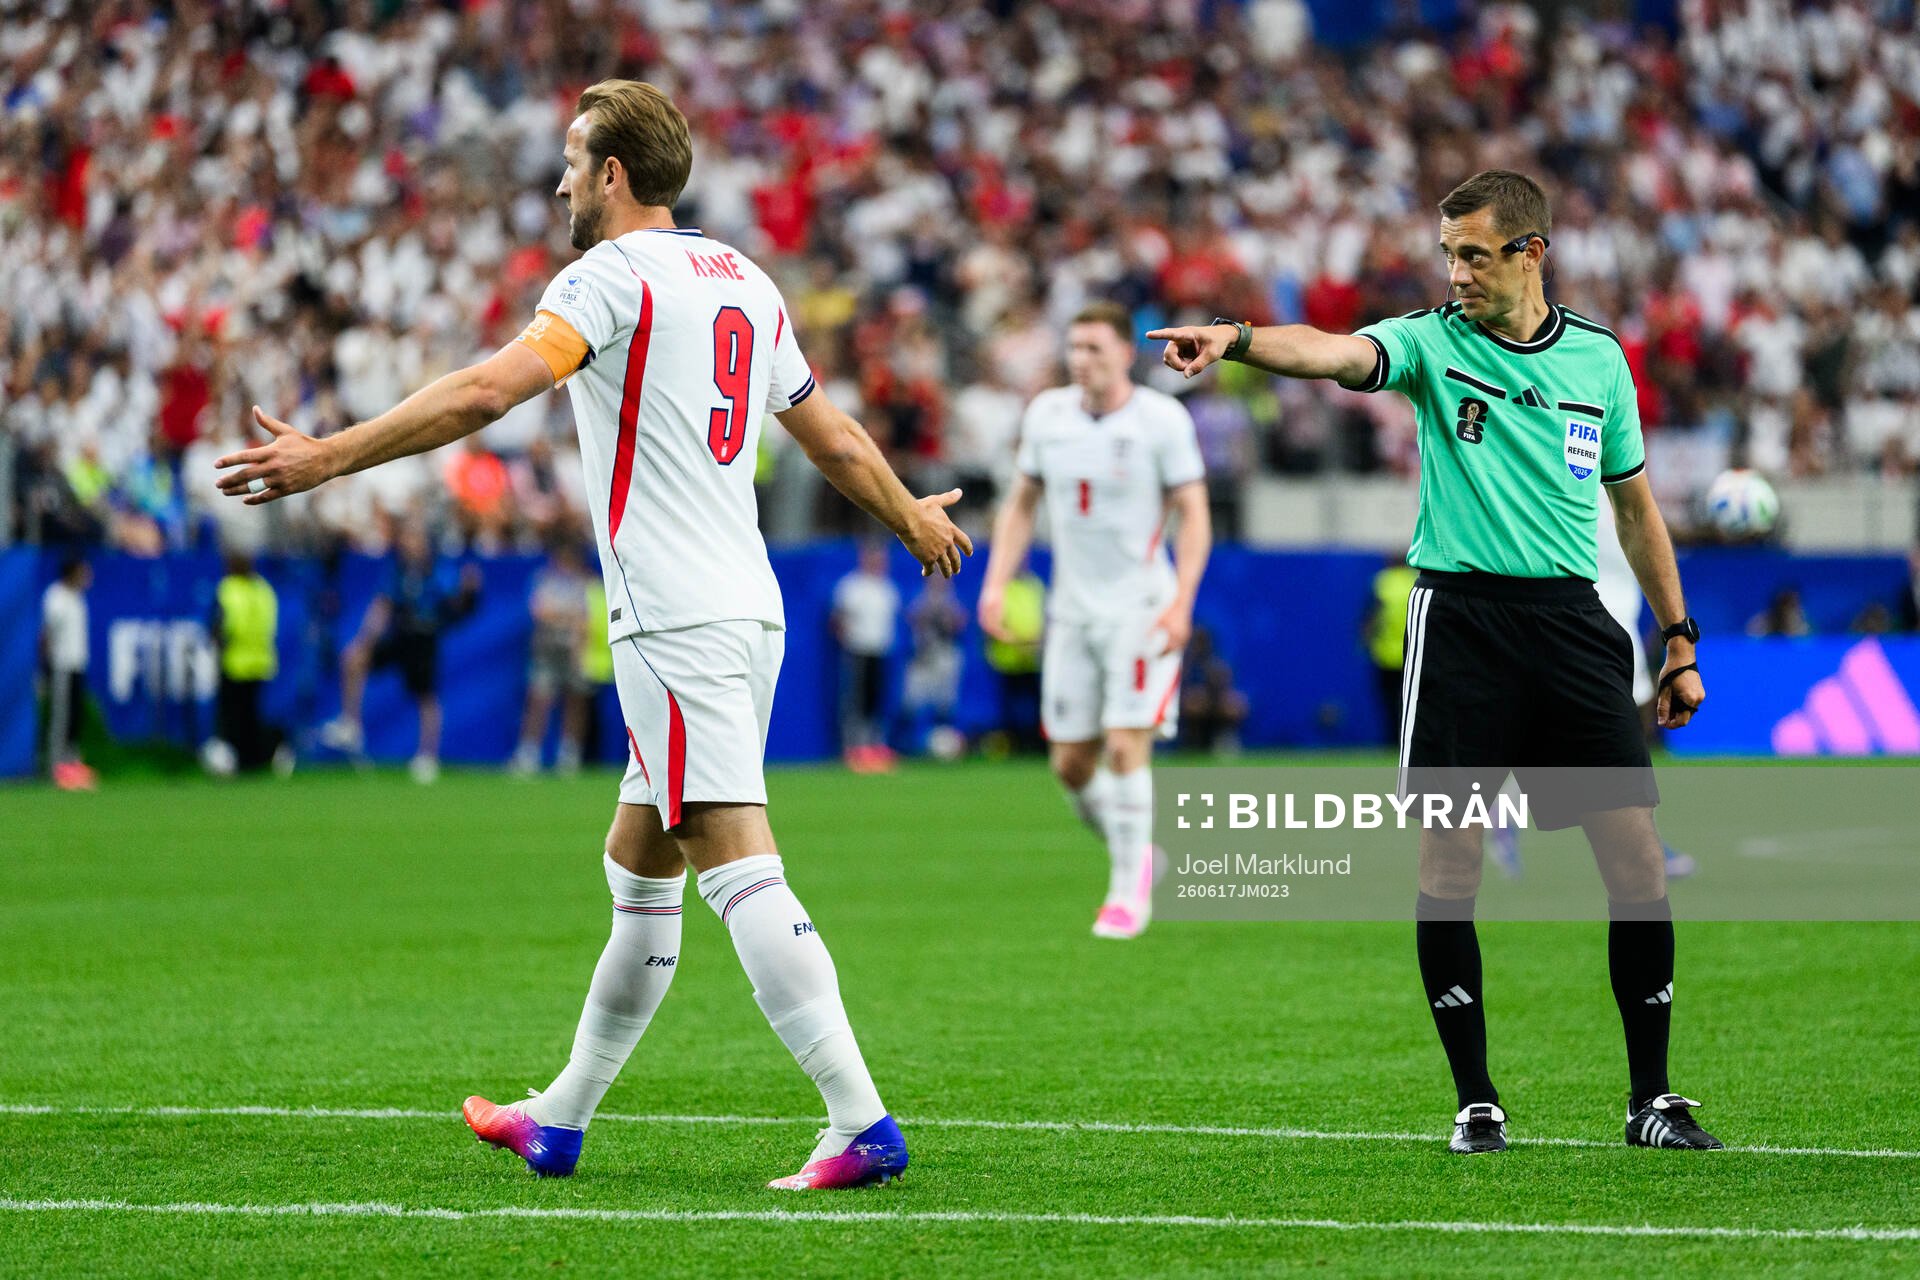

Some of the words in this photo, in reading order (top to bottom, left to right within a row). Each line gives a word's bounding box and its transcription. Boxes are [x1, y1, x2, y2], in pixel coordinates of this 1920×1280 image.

[684, 249, 745, 281] KANE
[707, 305, 755, 466] 9
[1463, 432, 1476, 441] FIFA
[1569, 423, 1598, 443] FIFA
[1567, 446, 1597, 460] REFEREE
[1573, 467, 1589, 477] 2026
[645, 955, 676, 967] ENG
